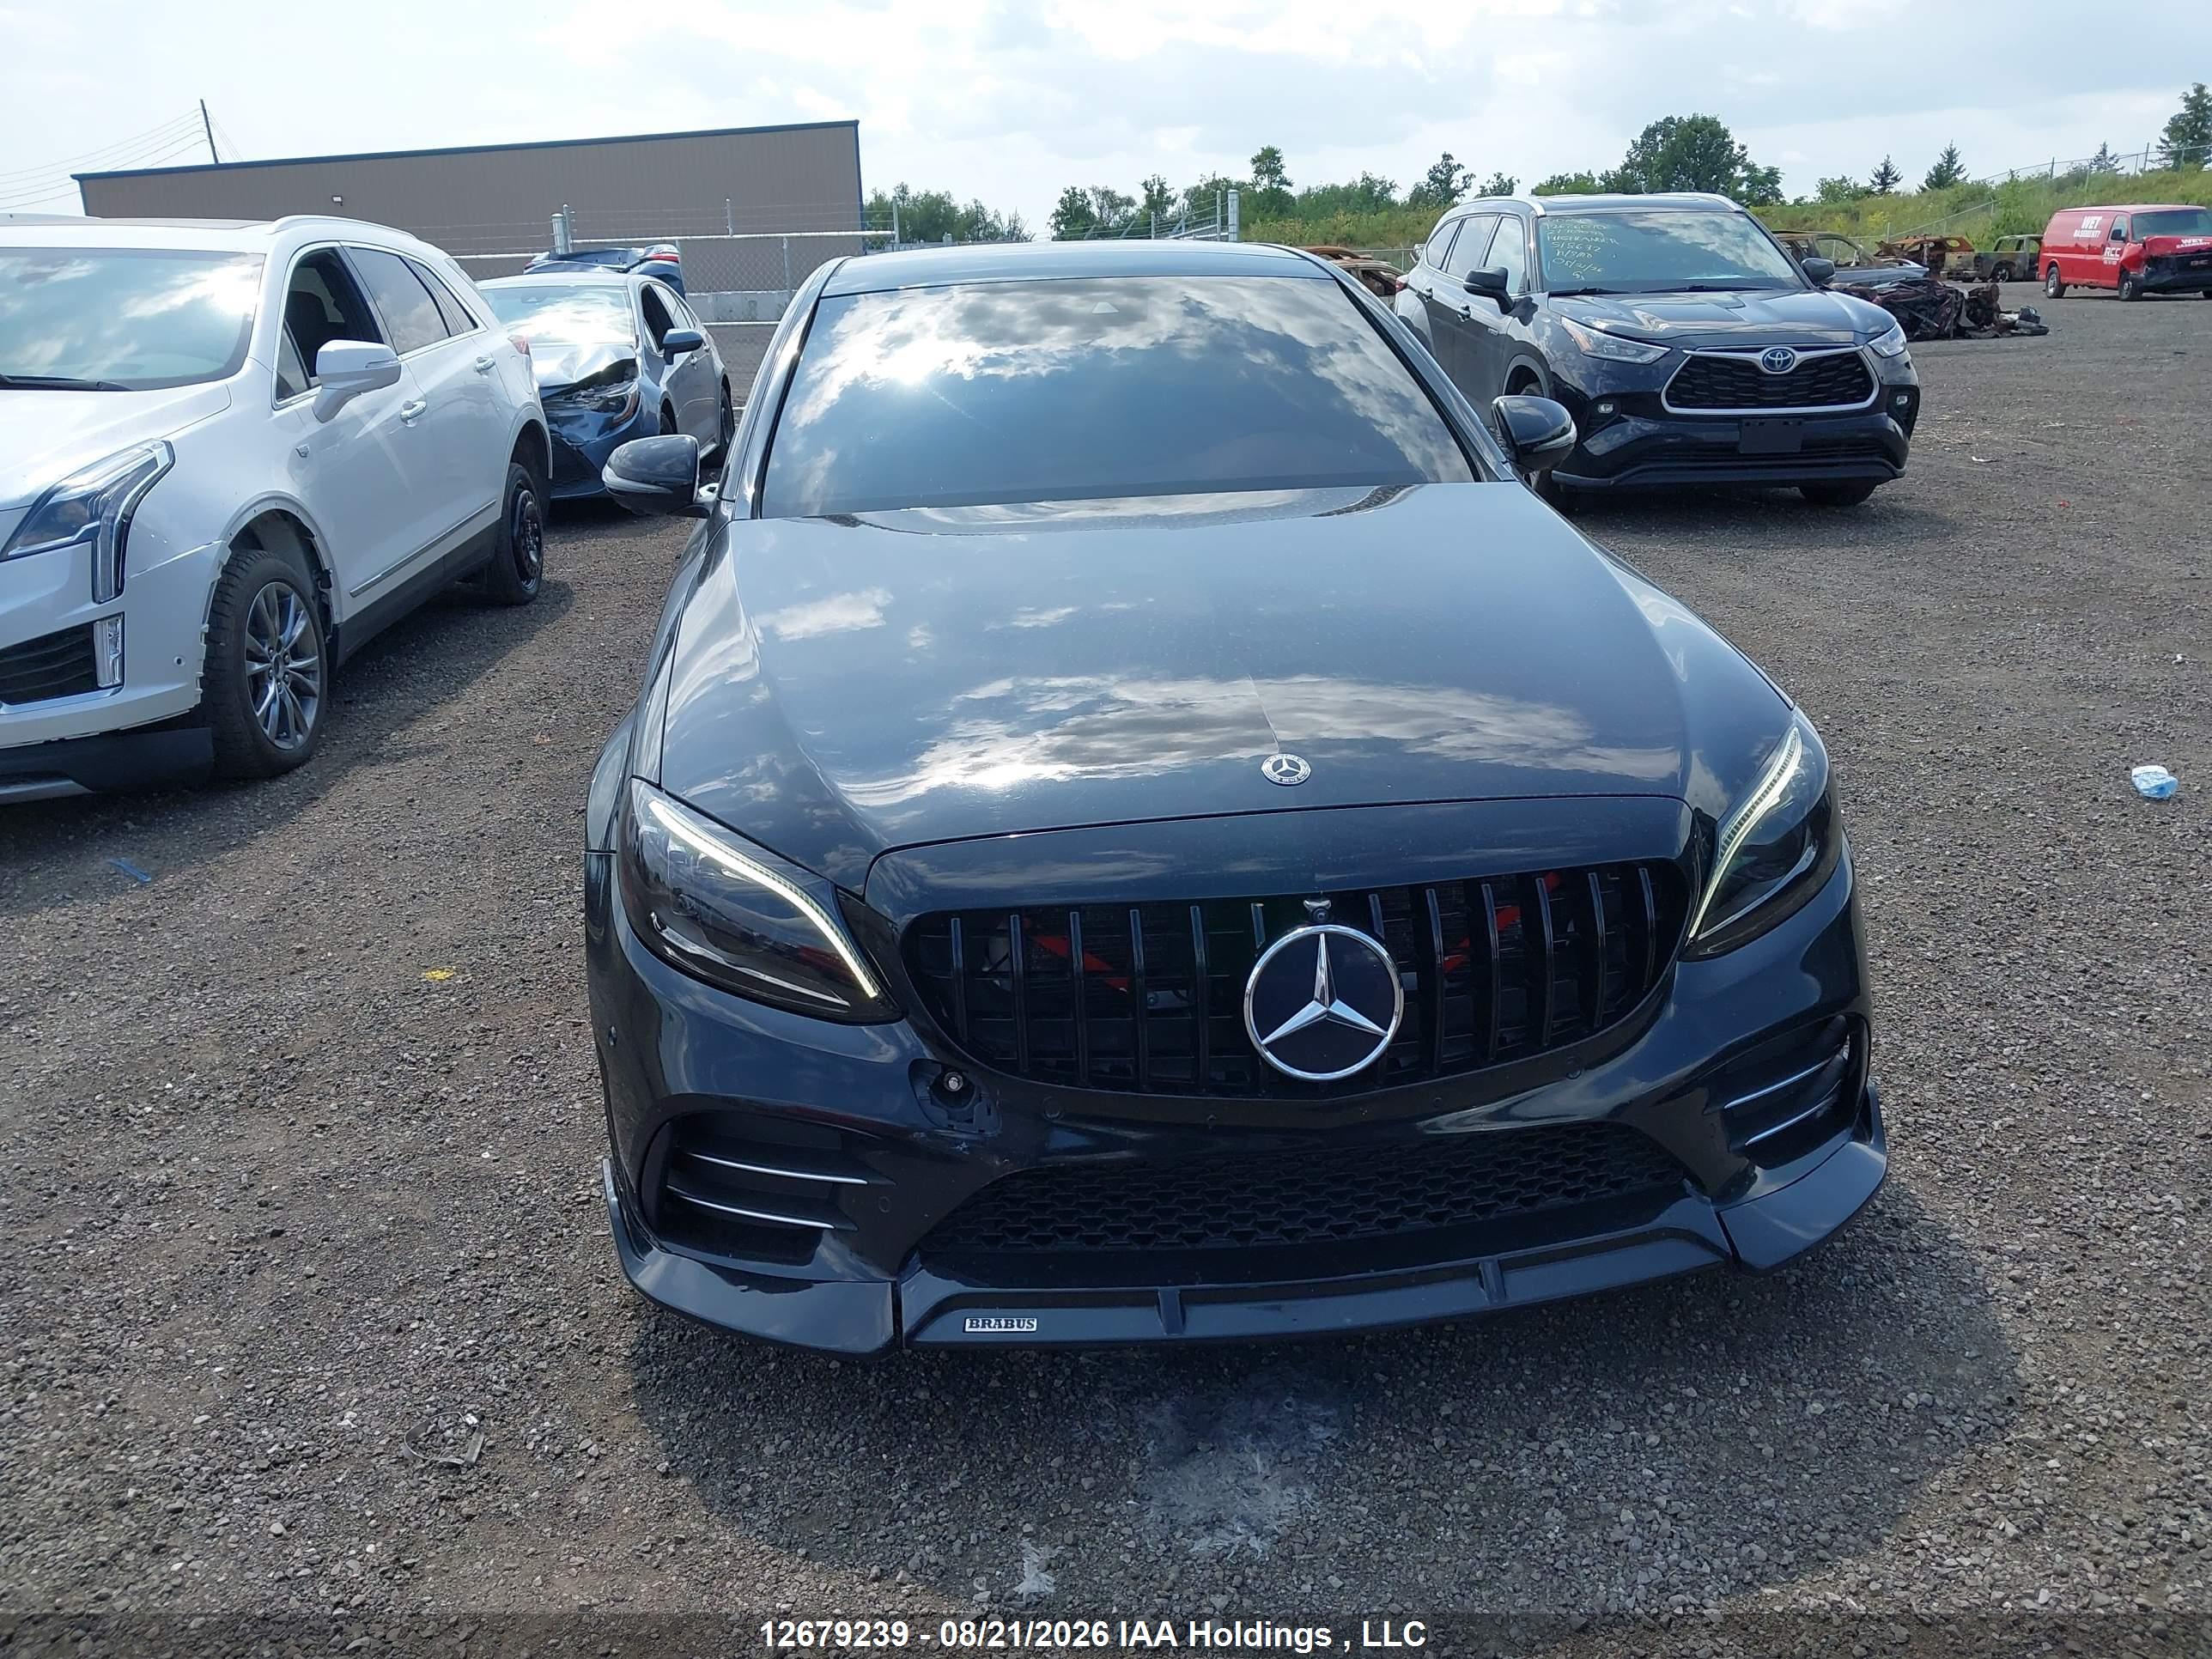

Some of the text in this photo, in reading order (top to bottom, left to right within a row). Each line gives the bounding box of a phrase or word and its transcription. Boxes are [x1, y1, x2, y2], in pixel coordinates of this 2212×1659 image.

[2081, 216, 2102, 229] WET
[2104, 247, 2121, 258] RCC
[969, 1318, 1035, 1329] BRABUS
